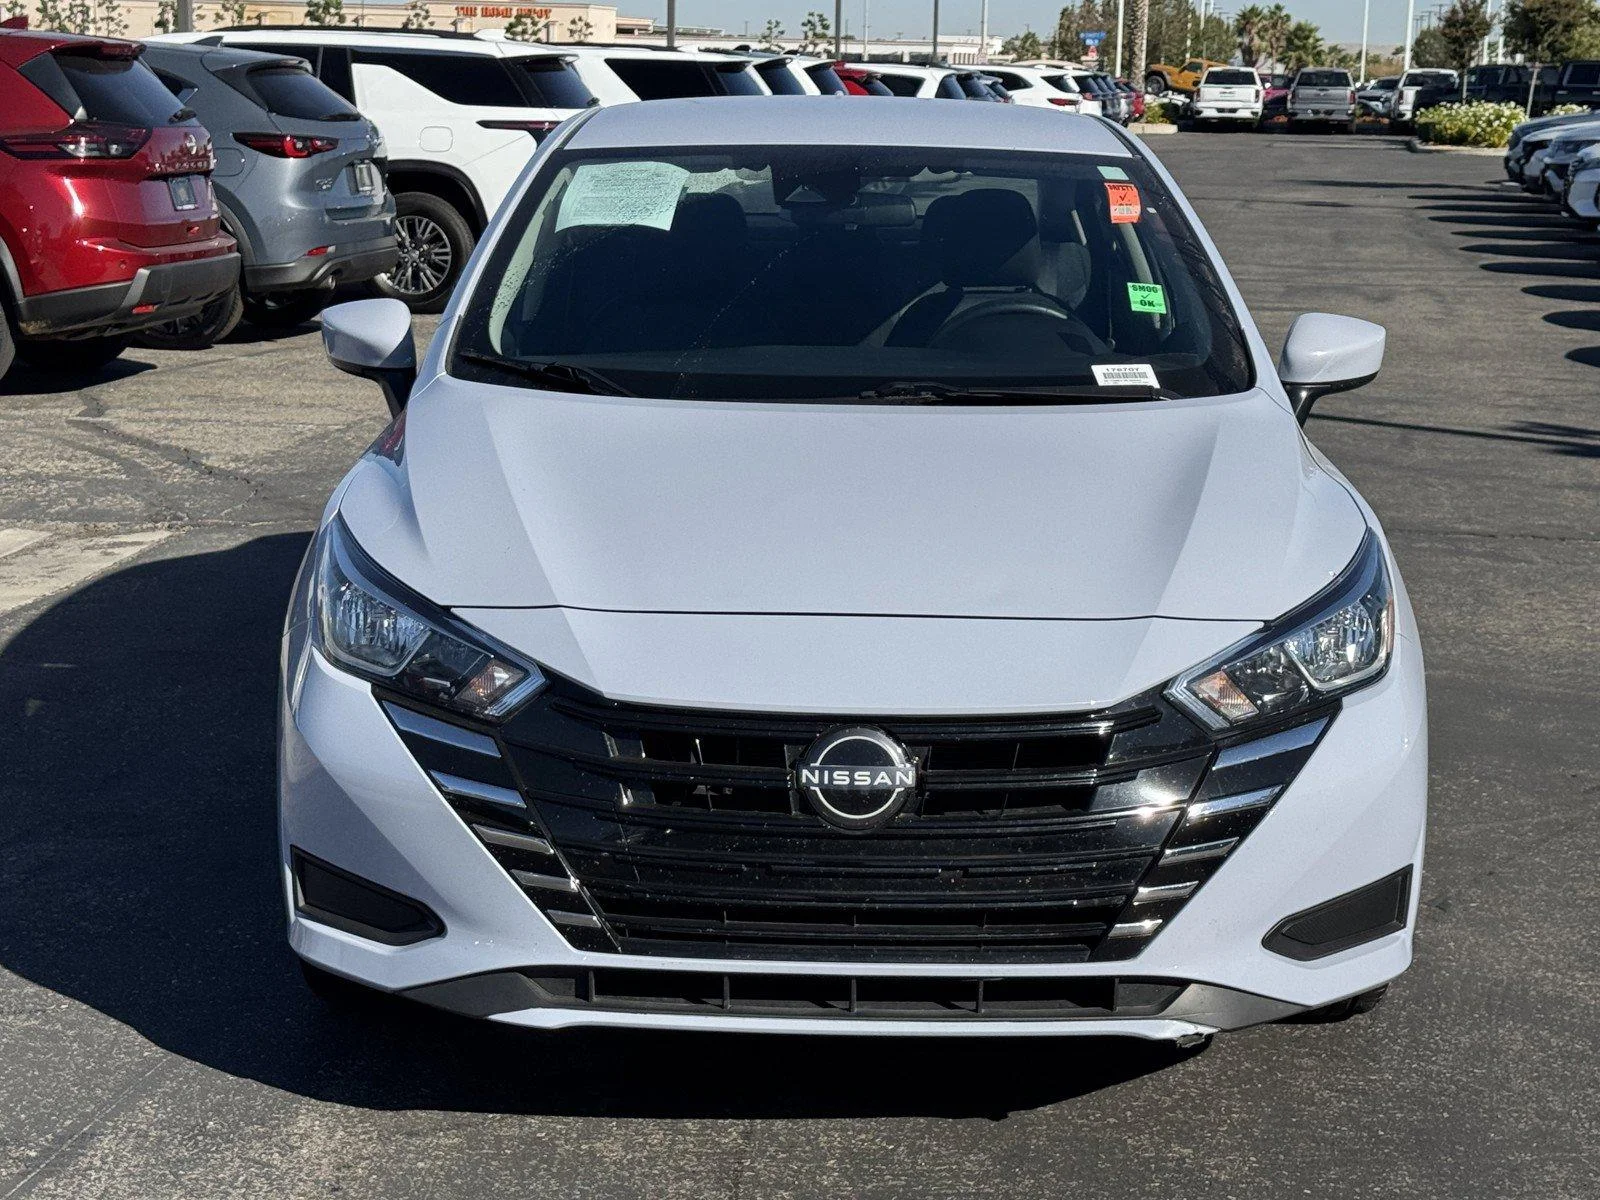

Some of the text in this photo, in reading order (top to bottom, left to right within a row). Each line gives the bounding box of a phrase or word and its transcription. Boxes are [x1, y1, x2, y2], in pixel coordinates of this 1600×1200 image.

[1131, 284, 1158, 294] SMOG
[1140, 299, 1155, 308] OK
[801, 768, 914, 786] NISSAN
